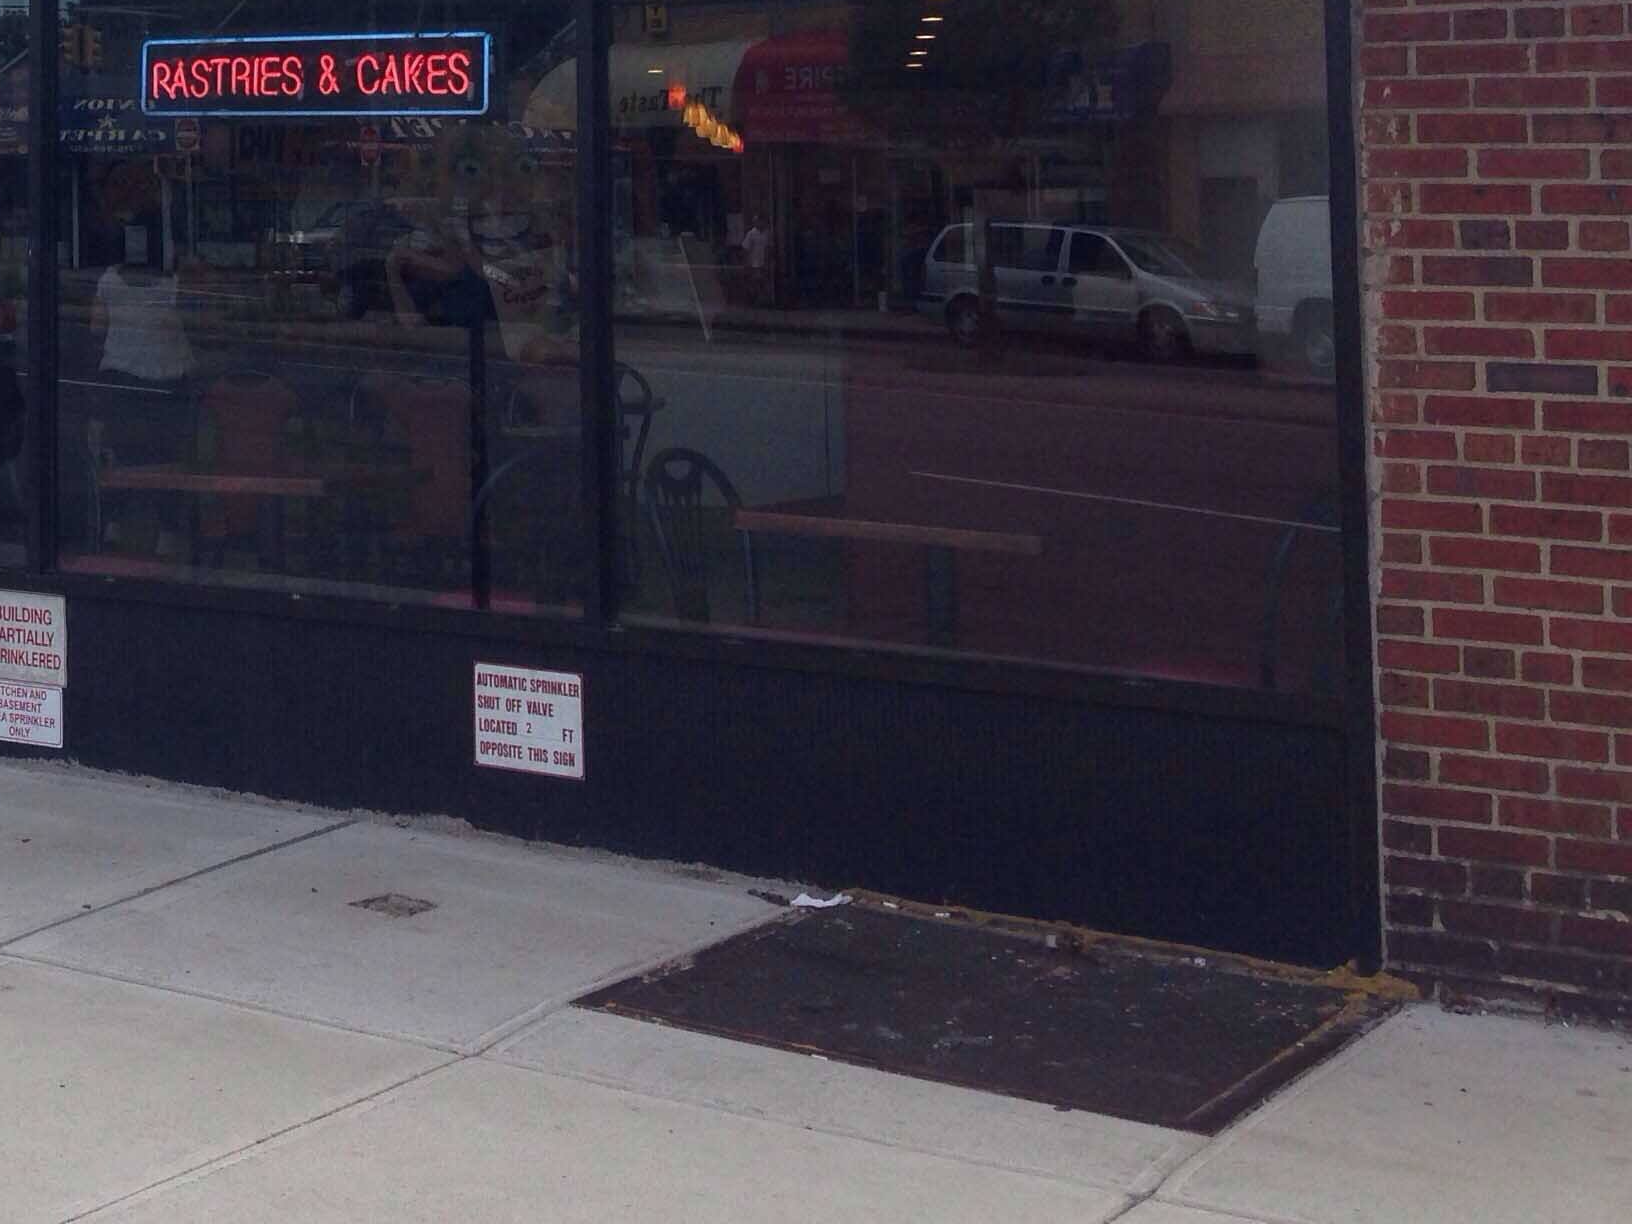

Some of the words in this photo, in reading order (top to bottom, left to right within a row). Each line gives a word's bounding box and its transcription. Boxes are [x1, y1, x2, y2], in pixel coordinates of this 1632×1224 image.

[318, 54, 341, 96] &
[356, 51, 471, 96] CAKES
[29, 689, 47, 701] AND
[477, 672, 527, 692] AUTOMATIC
[529, 678, 580, 698] SPRINKLER
[478, 694, 500, 710] SHUT
[505, 697, 522, 713] OFF
[526, 701, 555, 718] VALVE
[9, 713, 56, 728] SPRINKLER
[9, 726, 31, 738] ONLY
[479, 717, 518, 736] LOCATED
[526, 722, 532, 734] 2
[562, 728, 574, 744] FT
[480, 740, 523, 760] OPPOSITE
[527, 747, 549, 763] THIS
[553, 751, 576, 767] SIGN
